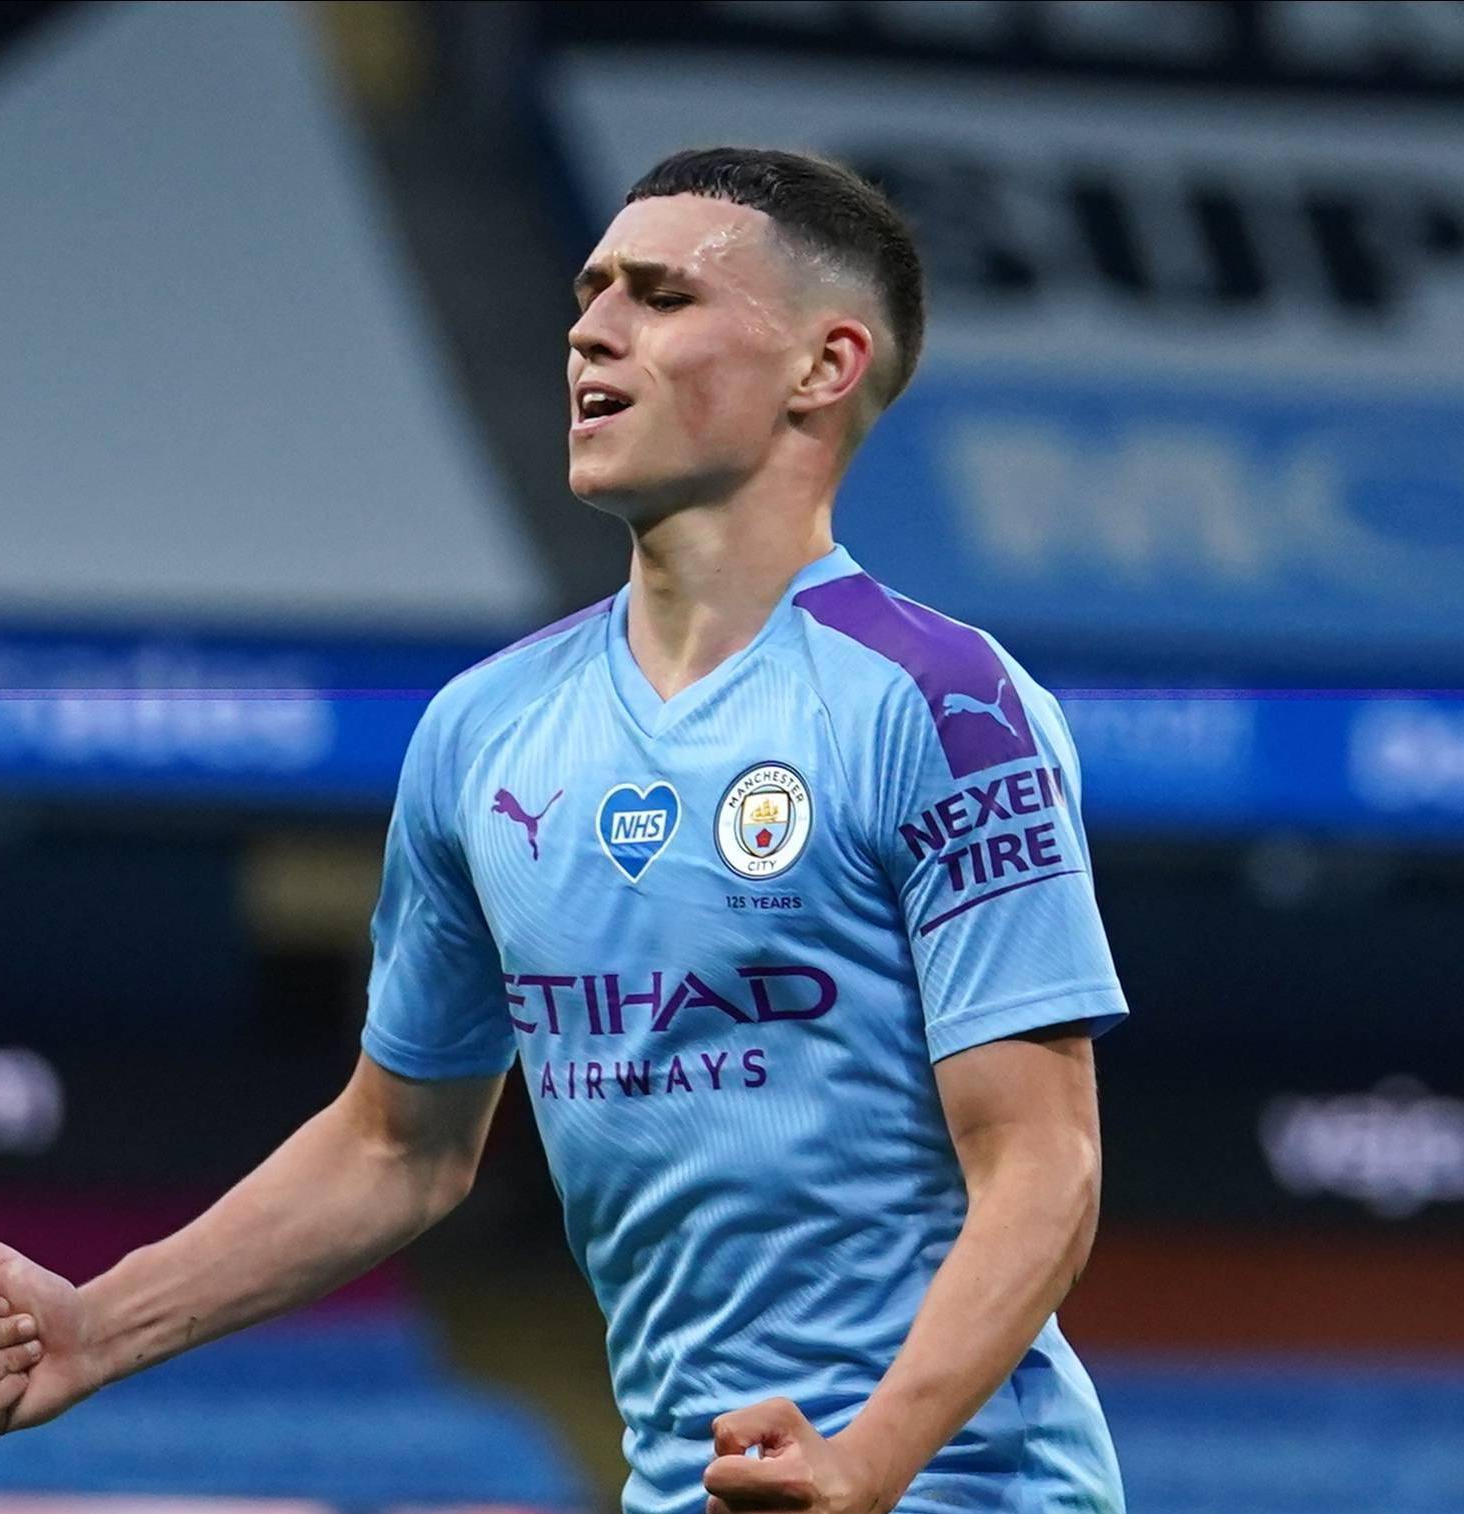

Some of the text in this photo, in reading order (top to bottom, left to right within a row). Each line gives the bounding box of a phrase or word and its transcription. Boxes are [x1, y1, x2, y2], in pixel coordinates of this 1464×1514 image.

[728, 770, 804, 809] MANCHESTER
[614, 813, 663, 840] NHS
[898, 767, 1065, 862] NEXEN
[747, 859, 777, 872] CITY
[937, 822, 1062, 891] TIRE
[725, 896, 803, 909] 125 YEARS
[503, 965, 838, 1036] ETIHAD
[540, 1048, 768, 1100] AIRWAYS
